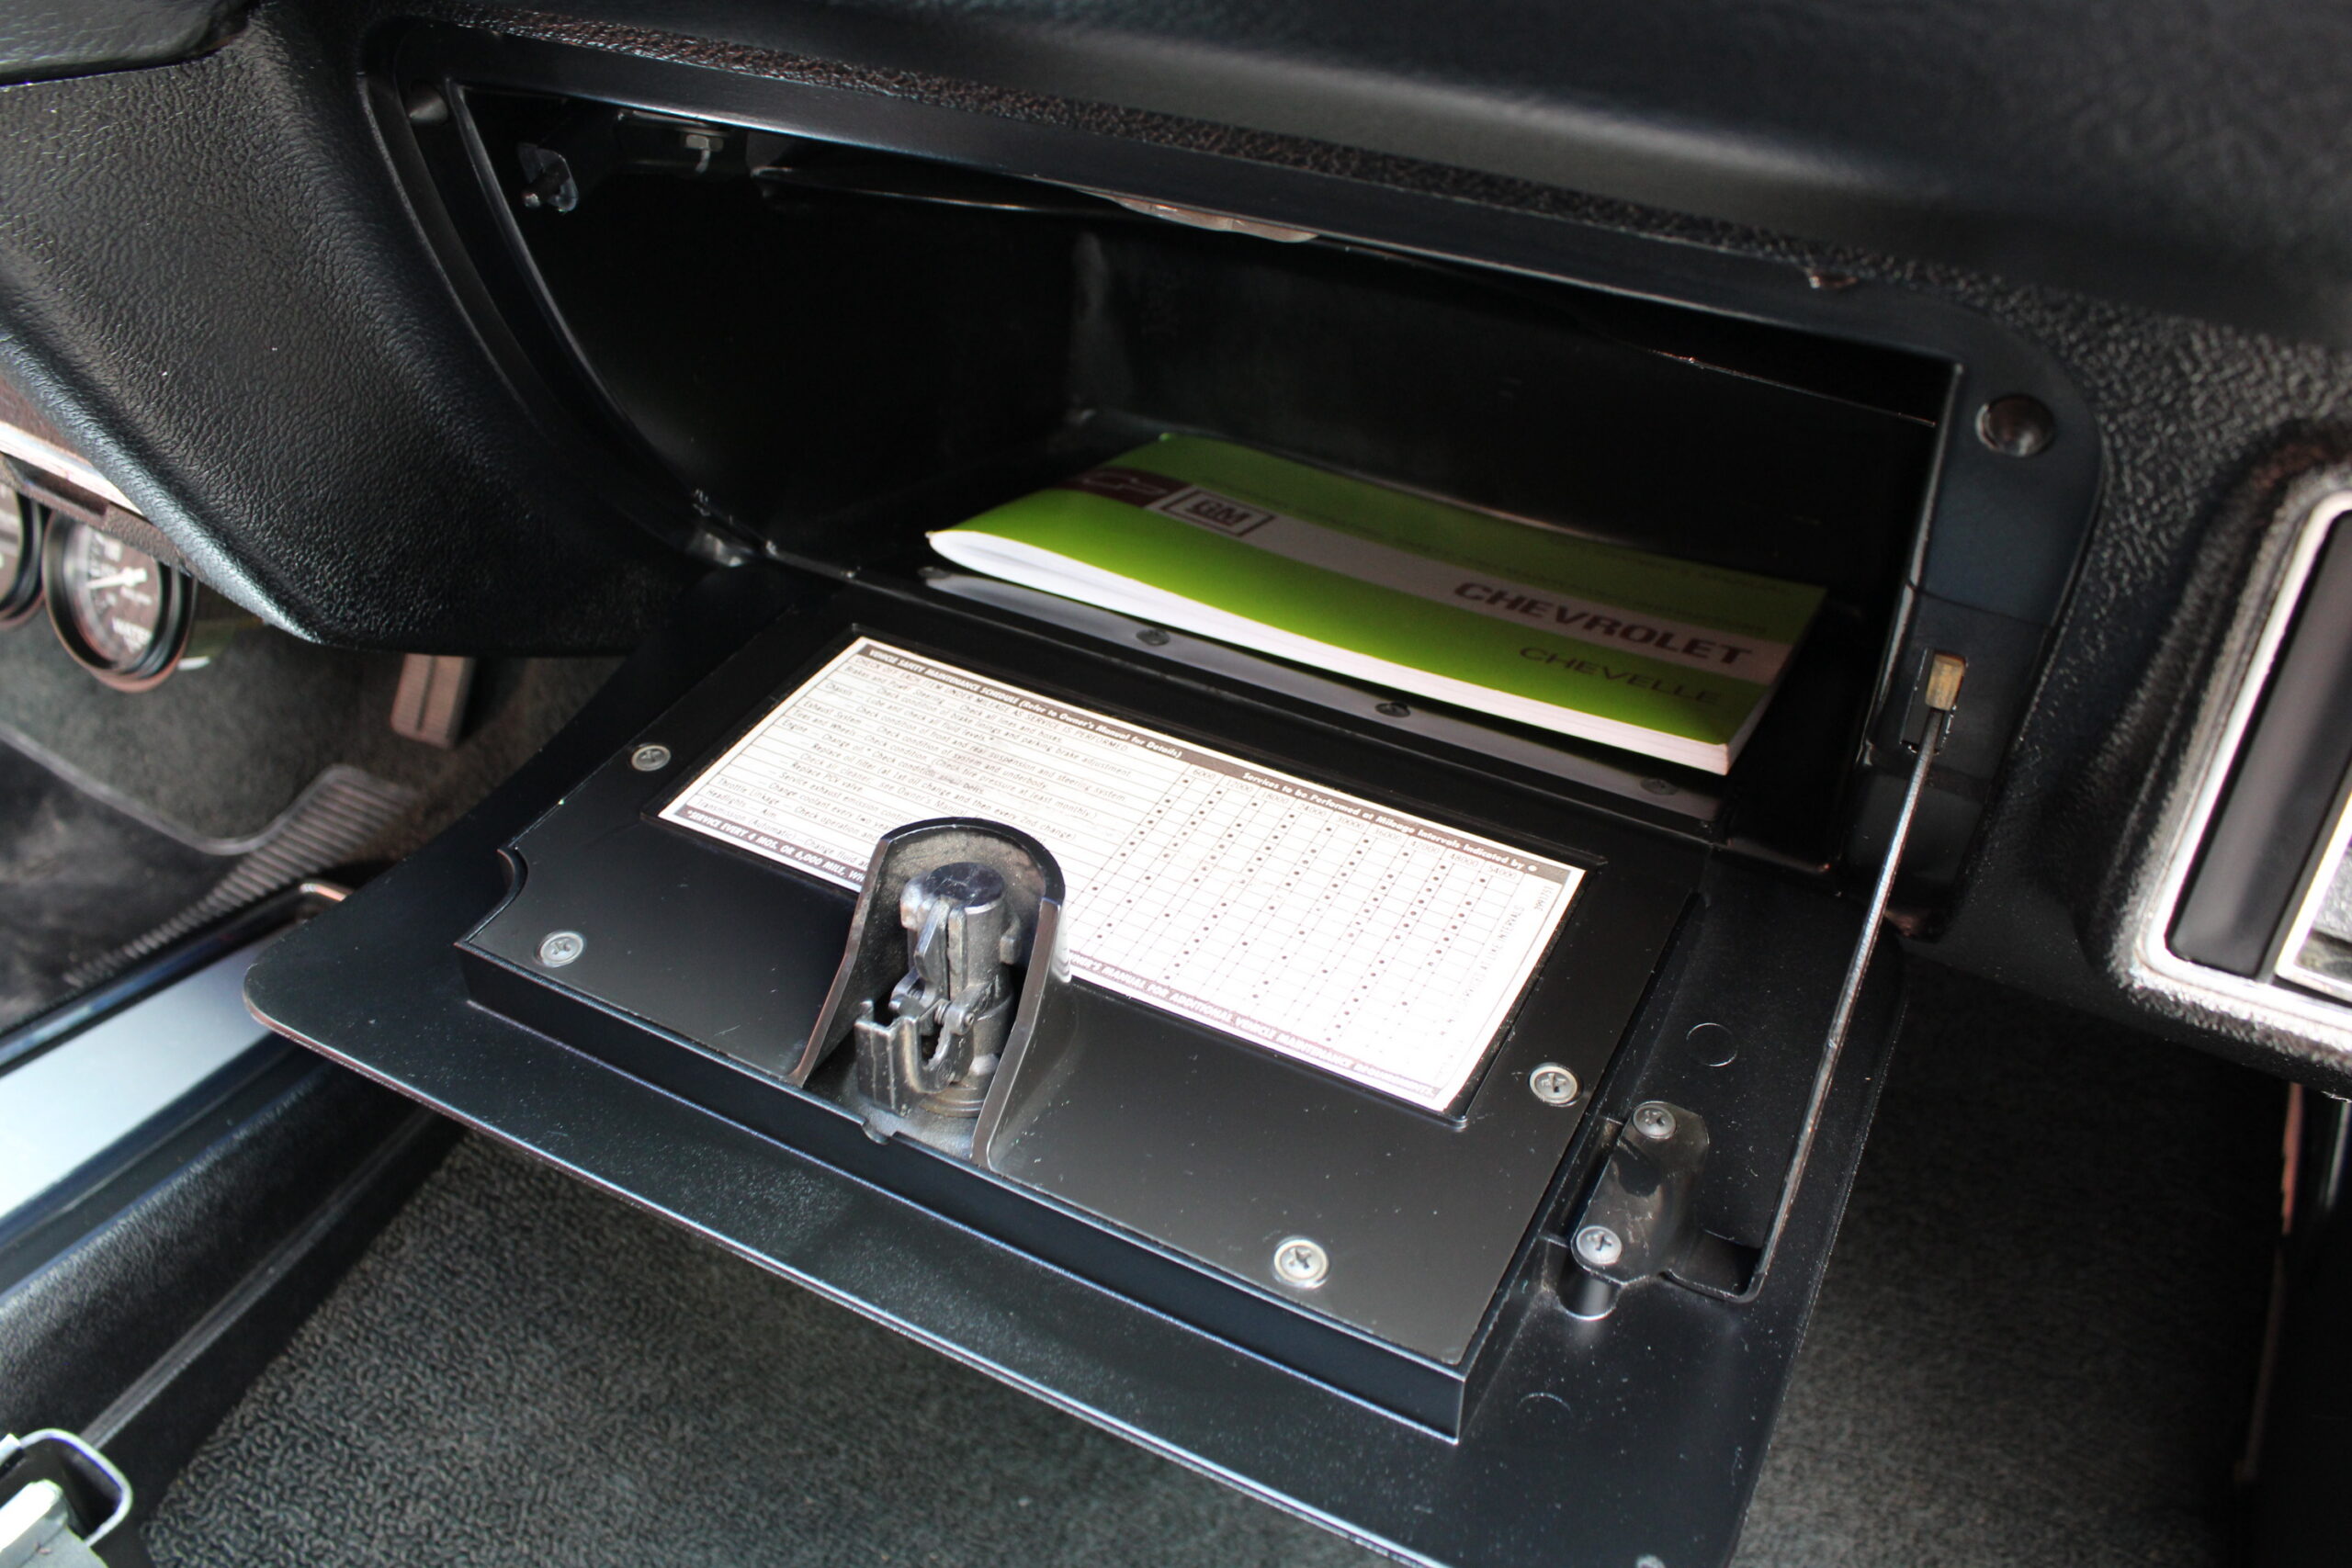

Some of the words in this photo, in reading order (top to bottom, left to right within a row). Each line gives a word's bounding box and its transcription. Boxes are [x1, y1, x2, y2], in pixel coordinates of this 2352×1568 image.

[1188, 498, 1250, 527] GM
[1453, 581, 1752, 664] CHEVROLET
[1519, 647, 1721, 705] CHEVELLE
[853, 657, 881, 670] CHECK
[879, 666, 899, 675] OFF
[898, 672, 922, 683] EACH
[921, 680, 944, 691] ITEM
[943, 686, 974, 700] UNDER
[973, 696, 1011, 712] MILEAGE
[1012, 709, 1024, 717] AS
[1023, 713, 1061, 728] SERVICE
[865, 649, 899, 664] VEHICLE
[895, 659, 926, 672] SAFETY
[922, 668, 982, 691] MAINTENANCE
[978, 685, 1021, 704] SCHEDULE
[1017, 699, 1048, 714] (Refer
[1046, 708, 1059, 717] to
[1057, 712, 1097, 729] Owner's
[1093, 724, 1131, 740] Manual
[1129, 736, 1147, 746] for
[1145, 740, 1184, 758] Details)
[1191, 768, 1216, 781] 6000
[1224, 779, 1254, 793] 12000
[1261, 791, 1290, 805] 18000
[1296, 802, 1328, 818] 24000
[1241, 772, 1281, 789] Services
[1280, 784, 1294, 794] to
[1293, 789, 1309, 798] be
[1308, 794, 1362, 816] Performed
[1361, 810, 1375, 820] at
[1374, 815, 1416, 834] Mileage
[1417, 829, 1462, 848] Intervals
[1462, 843, 1510, 863] Indicated
[1509, 859, 1525, 870] by
[1334, 815, 1365, 829] 30000
[1372, 827, 1403, 842] 36000
[718, 823, 748, 838] EVERY
[745, 832, 756, 840] 4
[777, 845, 796, 855] OR
[792, 851, 823, 865] 6,000
[1409, 839, 1441, 854] 42000
[1448, 852, 1480, 867] 48000
[1486, 864, 1518, 880] 54000
[1100, 965, 1148, 988] MANUAL
[1146, 983, 1170, 998] FOR
[1168, 992, 1235, 1022] ADDITIONAL
